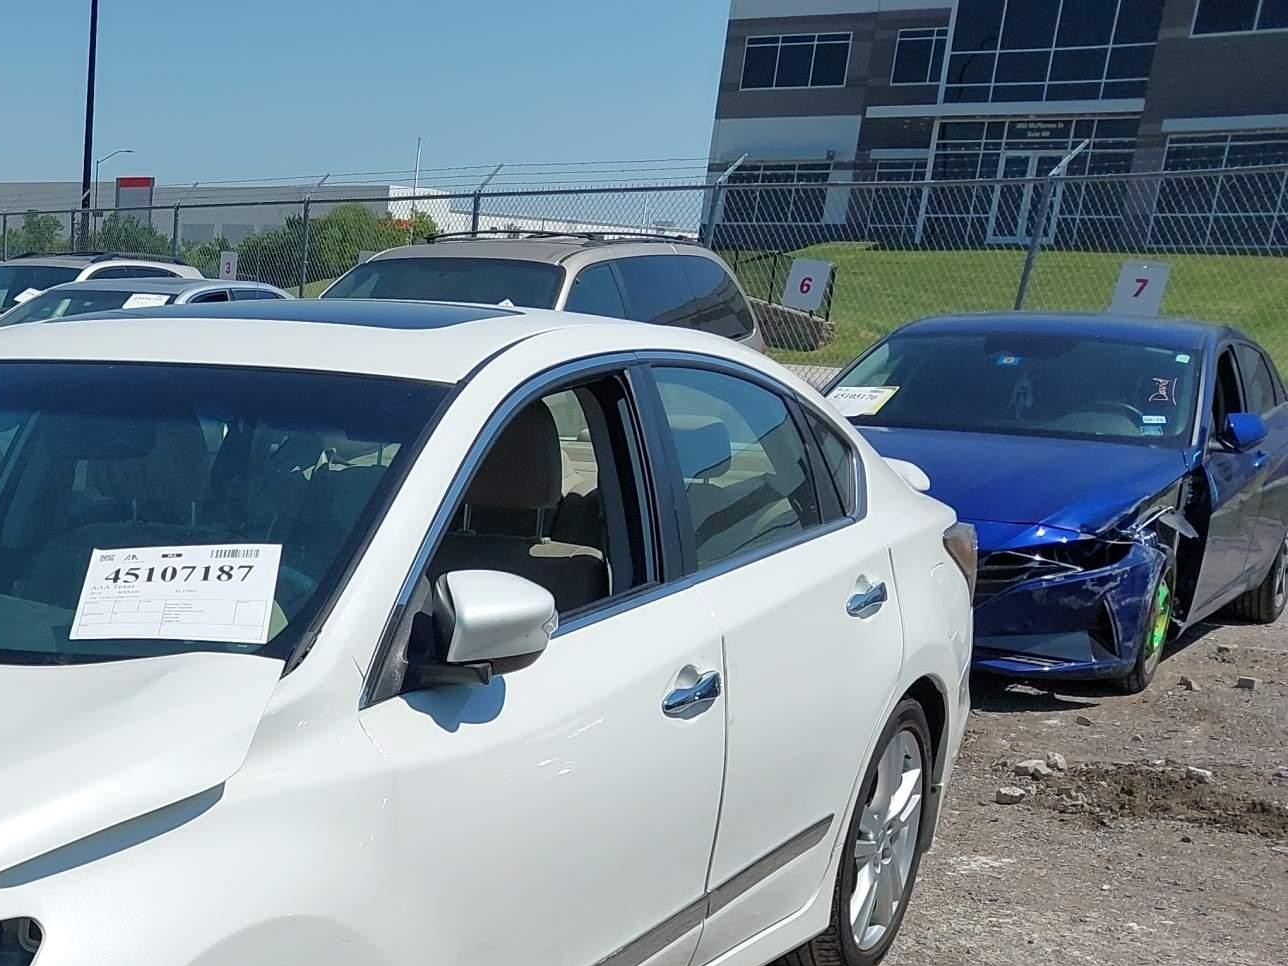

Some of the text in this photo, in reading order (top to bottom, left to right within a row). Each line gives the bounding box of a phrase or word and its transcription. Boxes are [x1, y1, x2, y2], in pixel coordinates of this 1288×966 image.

[225, 262, 231, 274] 3
[799, 277, 813, 294] 6
[1133, 279, 1149, 297] 7
[104, 564, 255, 584] 45107187
